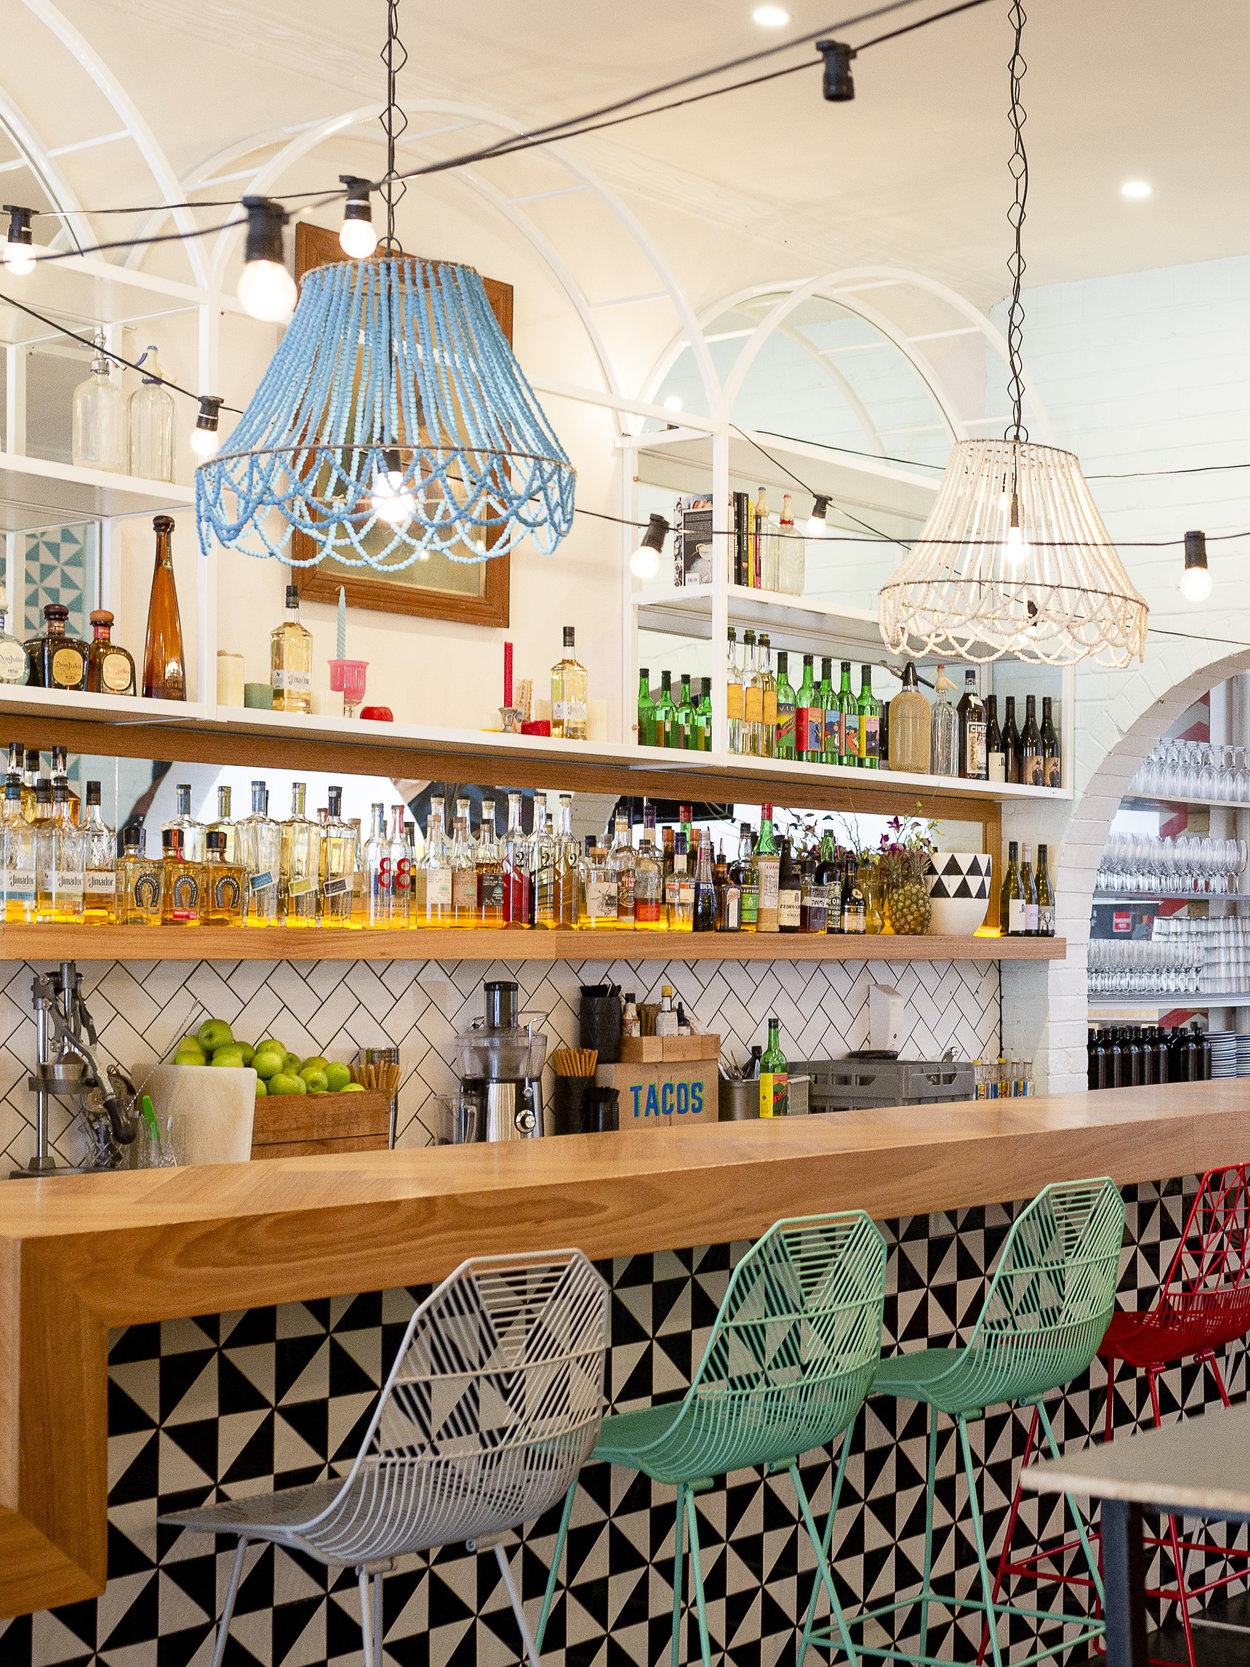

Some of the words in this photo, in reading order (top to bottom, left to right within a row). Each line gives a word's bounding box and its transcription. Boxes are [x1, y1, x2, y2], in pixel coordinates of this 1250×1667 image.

[379, 857, 391, 888] 8
[396, 858, 410, 889] 8
[629, 1080, 704, 1118] TACOS
